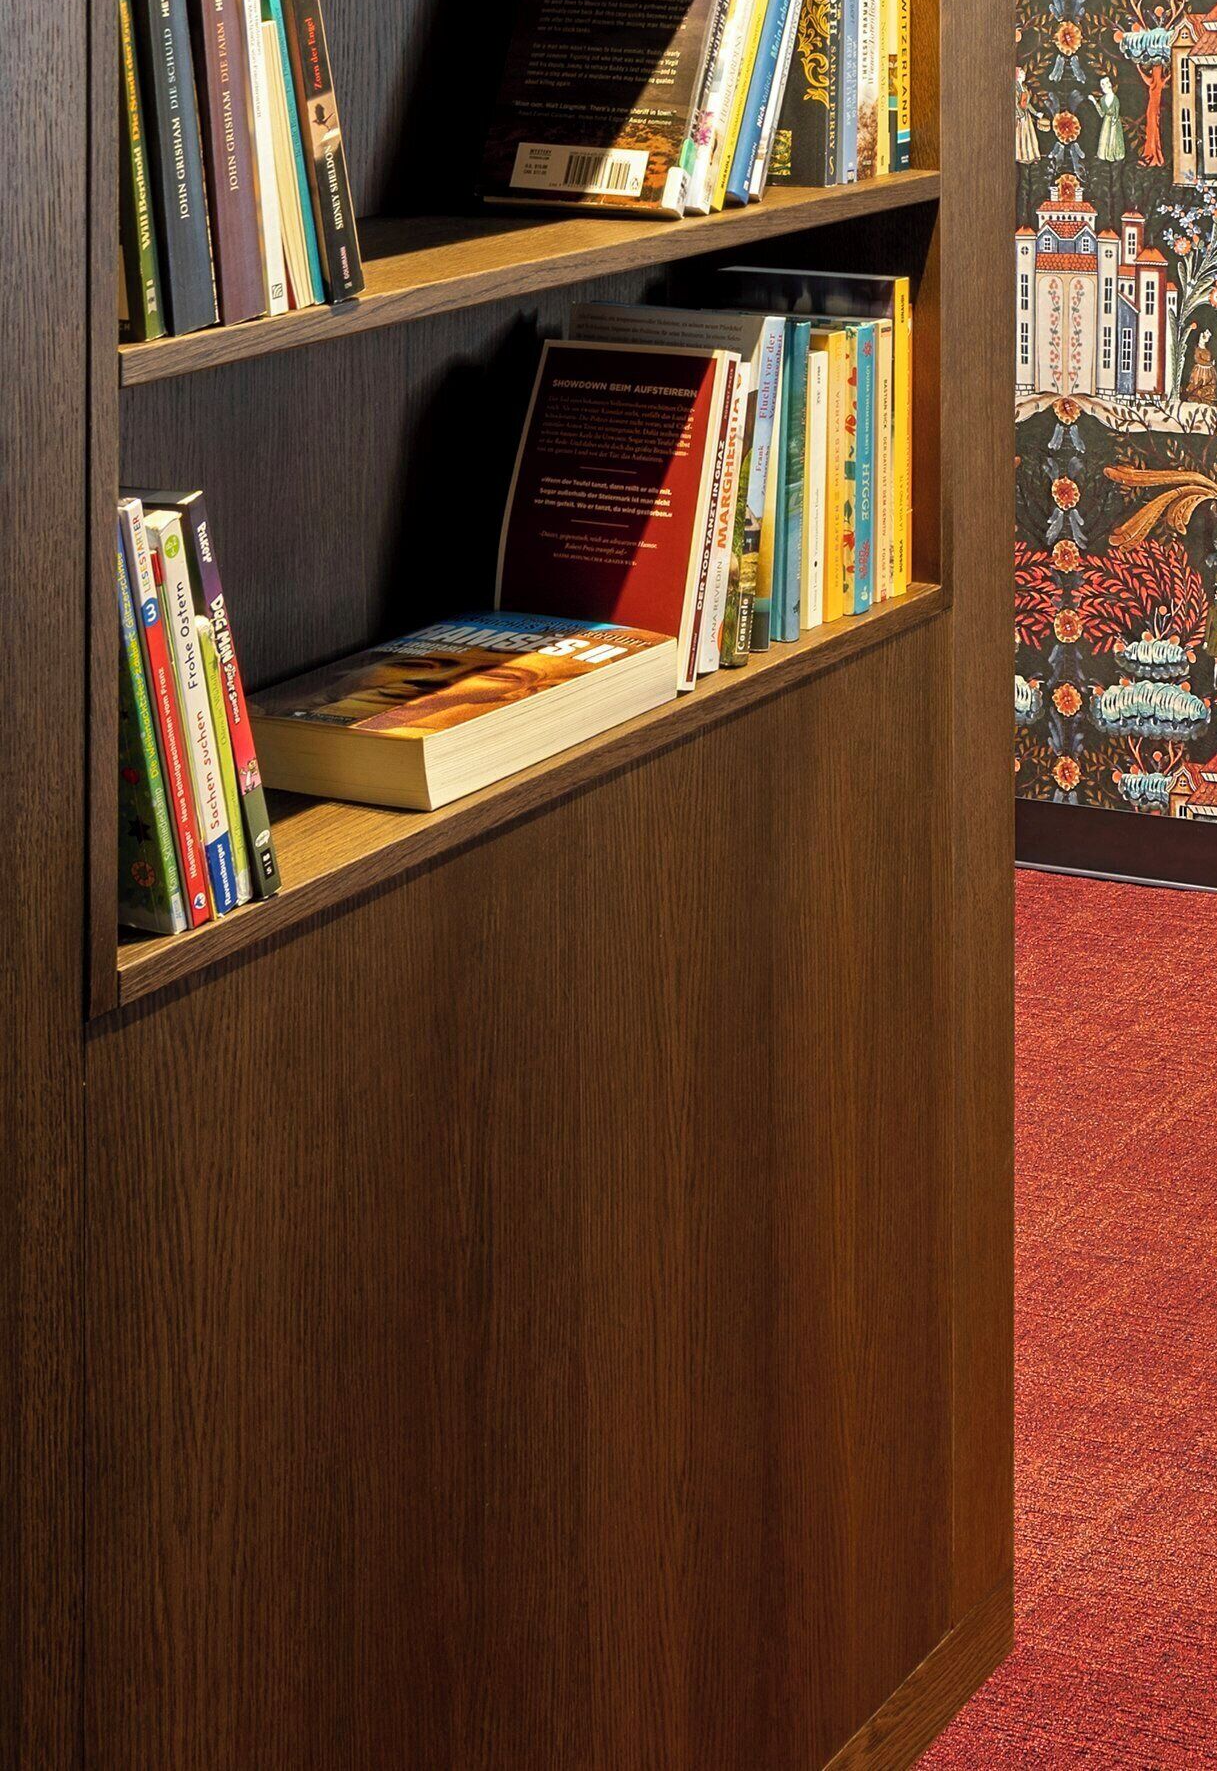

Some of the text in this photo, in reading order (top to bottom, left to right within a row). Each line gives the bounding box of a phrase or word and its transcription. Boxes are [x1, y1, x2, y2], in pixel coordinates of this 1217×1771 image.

[163, 28, 176, 84] SCHULD
[217, 22, 227, 55] FARM
[304, 17, 322, 90] Zorn der Engel
[770, 32, 782, 59] Mein
[220, 57, 228, 82] DIE
[829, 45, 837, 96] SARAH
[169, 88, 178, 110] DIE
[221, 90, 234, 156] GRISHAM
[757, 106, 766, 127] Nick
[172, 117, 186, 180] GRISHAM
[228, 157, 239, 191] JOHN
[178, 185, 190, 219] JOHN
[324, 145, 344, 230] SIDNEY SHELDON
[139, 214, 151, 250] Will
[553, 379, 698, 398] SHOWDOWN BEIM AUFSTEIRERN
[759, 332, 776, 419] Flucht vor der
[756, 445, 764, 472] Frank
[598, 494, 630, 502] Steiermark
[860, 463, 870, 521] HYGGE
[197, 521, 212, 563] PILKEY
[697, 440, 725, 610] DER TOD TANZT IN GRAZ
[131, 514, 150, 593] LESESTARTER
[145, 604, 156, 622] 3
[210, 593, 235, 664] DOG MAN
[710, 561, 723, 643] JANA REVEDIN
[737, 599, 749, 650] Consuelo
[176, 581, 198, 690] Frohe Ostern
[570, 642, 628, 664] II
[117, 552, 160, 779] Die Weihnachtsfee zaubert Glitzerschnee
[158, 667, 197, 878] Nöstlinger Neue Schulgeschichten vom Franz
[197, 710, 220, 829] Sachen suchen
[217, 843, 231, 906] Ravensburger
